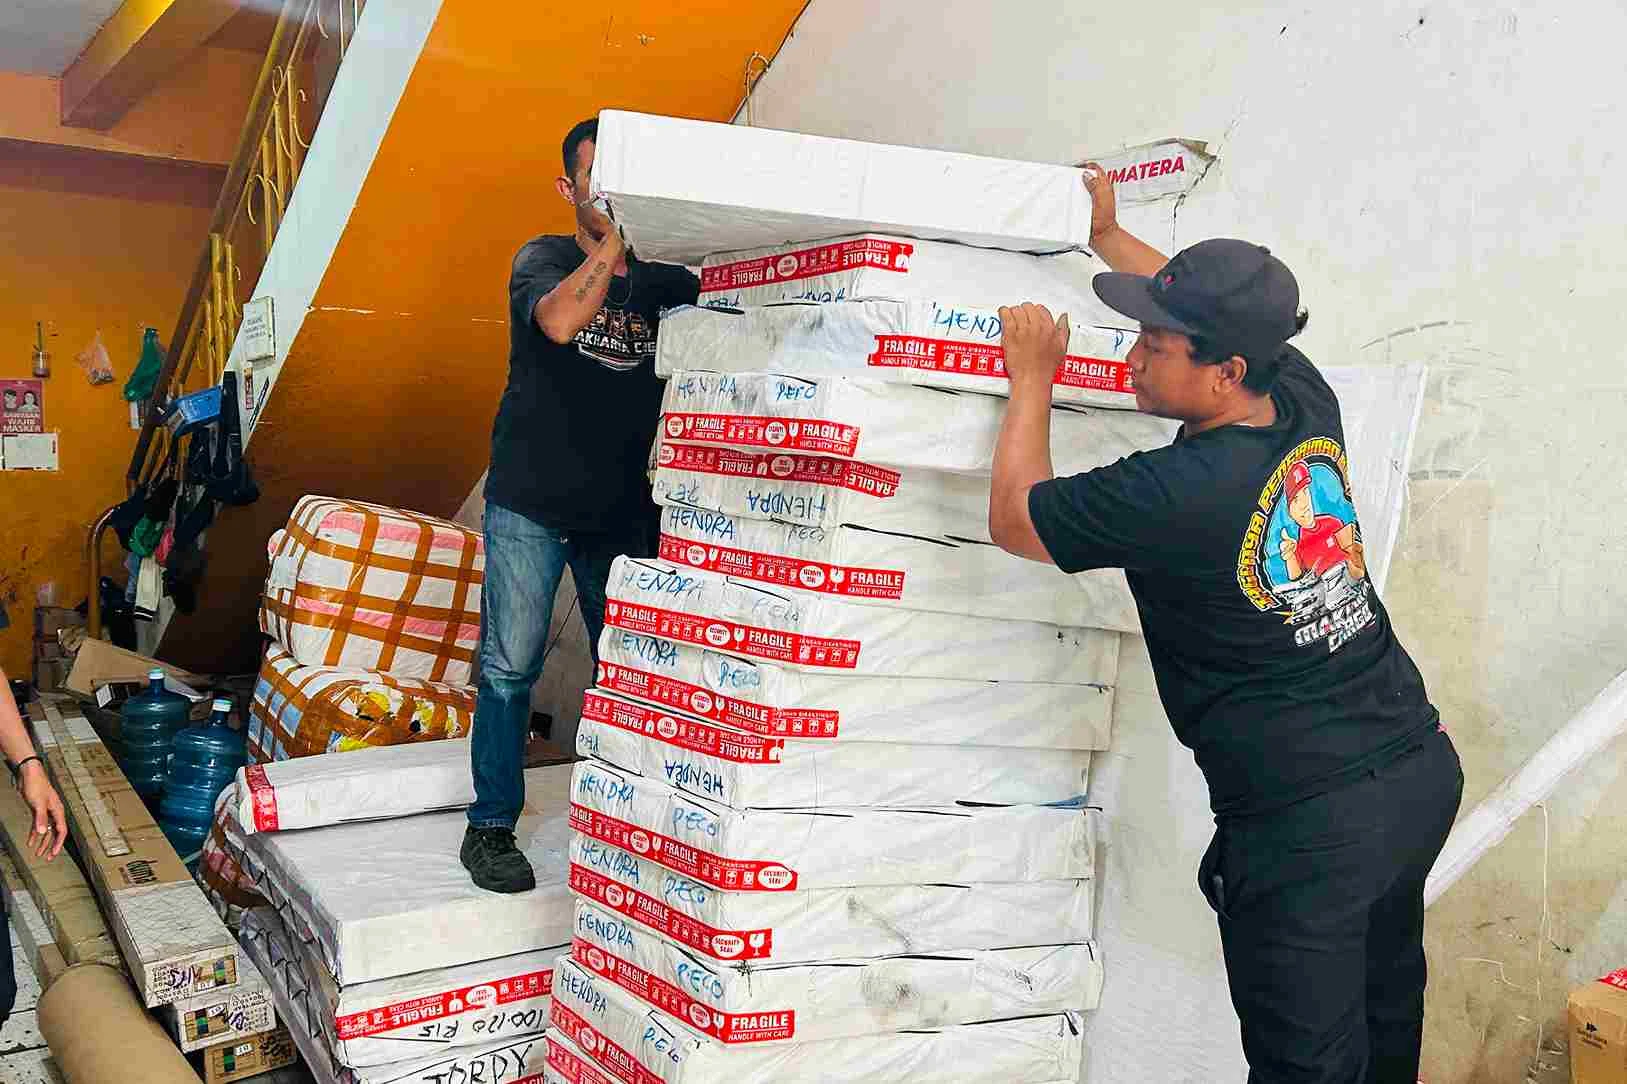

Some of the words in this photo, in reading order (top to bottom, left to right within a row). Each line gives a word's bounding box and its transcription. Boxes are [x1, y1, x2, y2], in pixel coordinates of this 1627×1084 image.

[1107, 156, 1185, 184] MATERA
[842, 252, 889, 265] FRAGILE
[732, 268, 763, 286] FRAGILE
[884, 340, 937, 356] FRAGILE
[1064, 360, 1117, 378] FRAGILE
[696, 417, 726, 430] FRAGILE
[802, 423, 851, 443] FRAGILE
[720, 551, 752, 566] FRAGILE
[850, 571, 902, 586] FRAGILE
[621, 606, 657, 623] FRAGILE
[749, 630, 793, 648] FRAGILE
[618, 669, 649, 687] FRAGILE
[612, 710, 643, 729] FRAGILE
[728, 700, 769, 722] FRAGILE
[719, 742, 763, 760] FRAGILE
[570, 805, 593, 822] RAGILE
[664, 841, 698, 864] FRAGILE
[637, 895, 669, 921] FRAGILE
[617, 961, 648, 987] FRAGILE
[392, 1004, 444, 1025] FRAGILE
[731, 1014, 789, 1030] FRAGILE
[606, 1044, 635, 1073] FRAGILE
